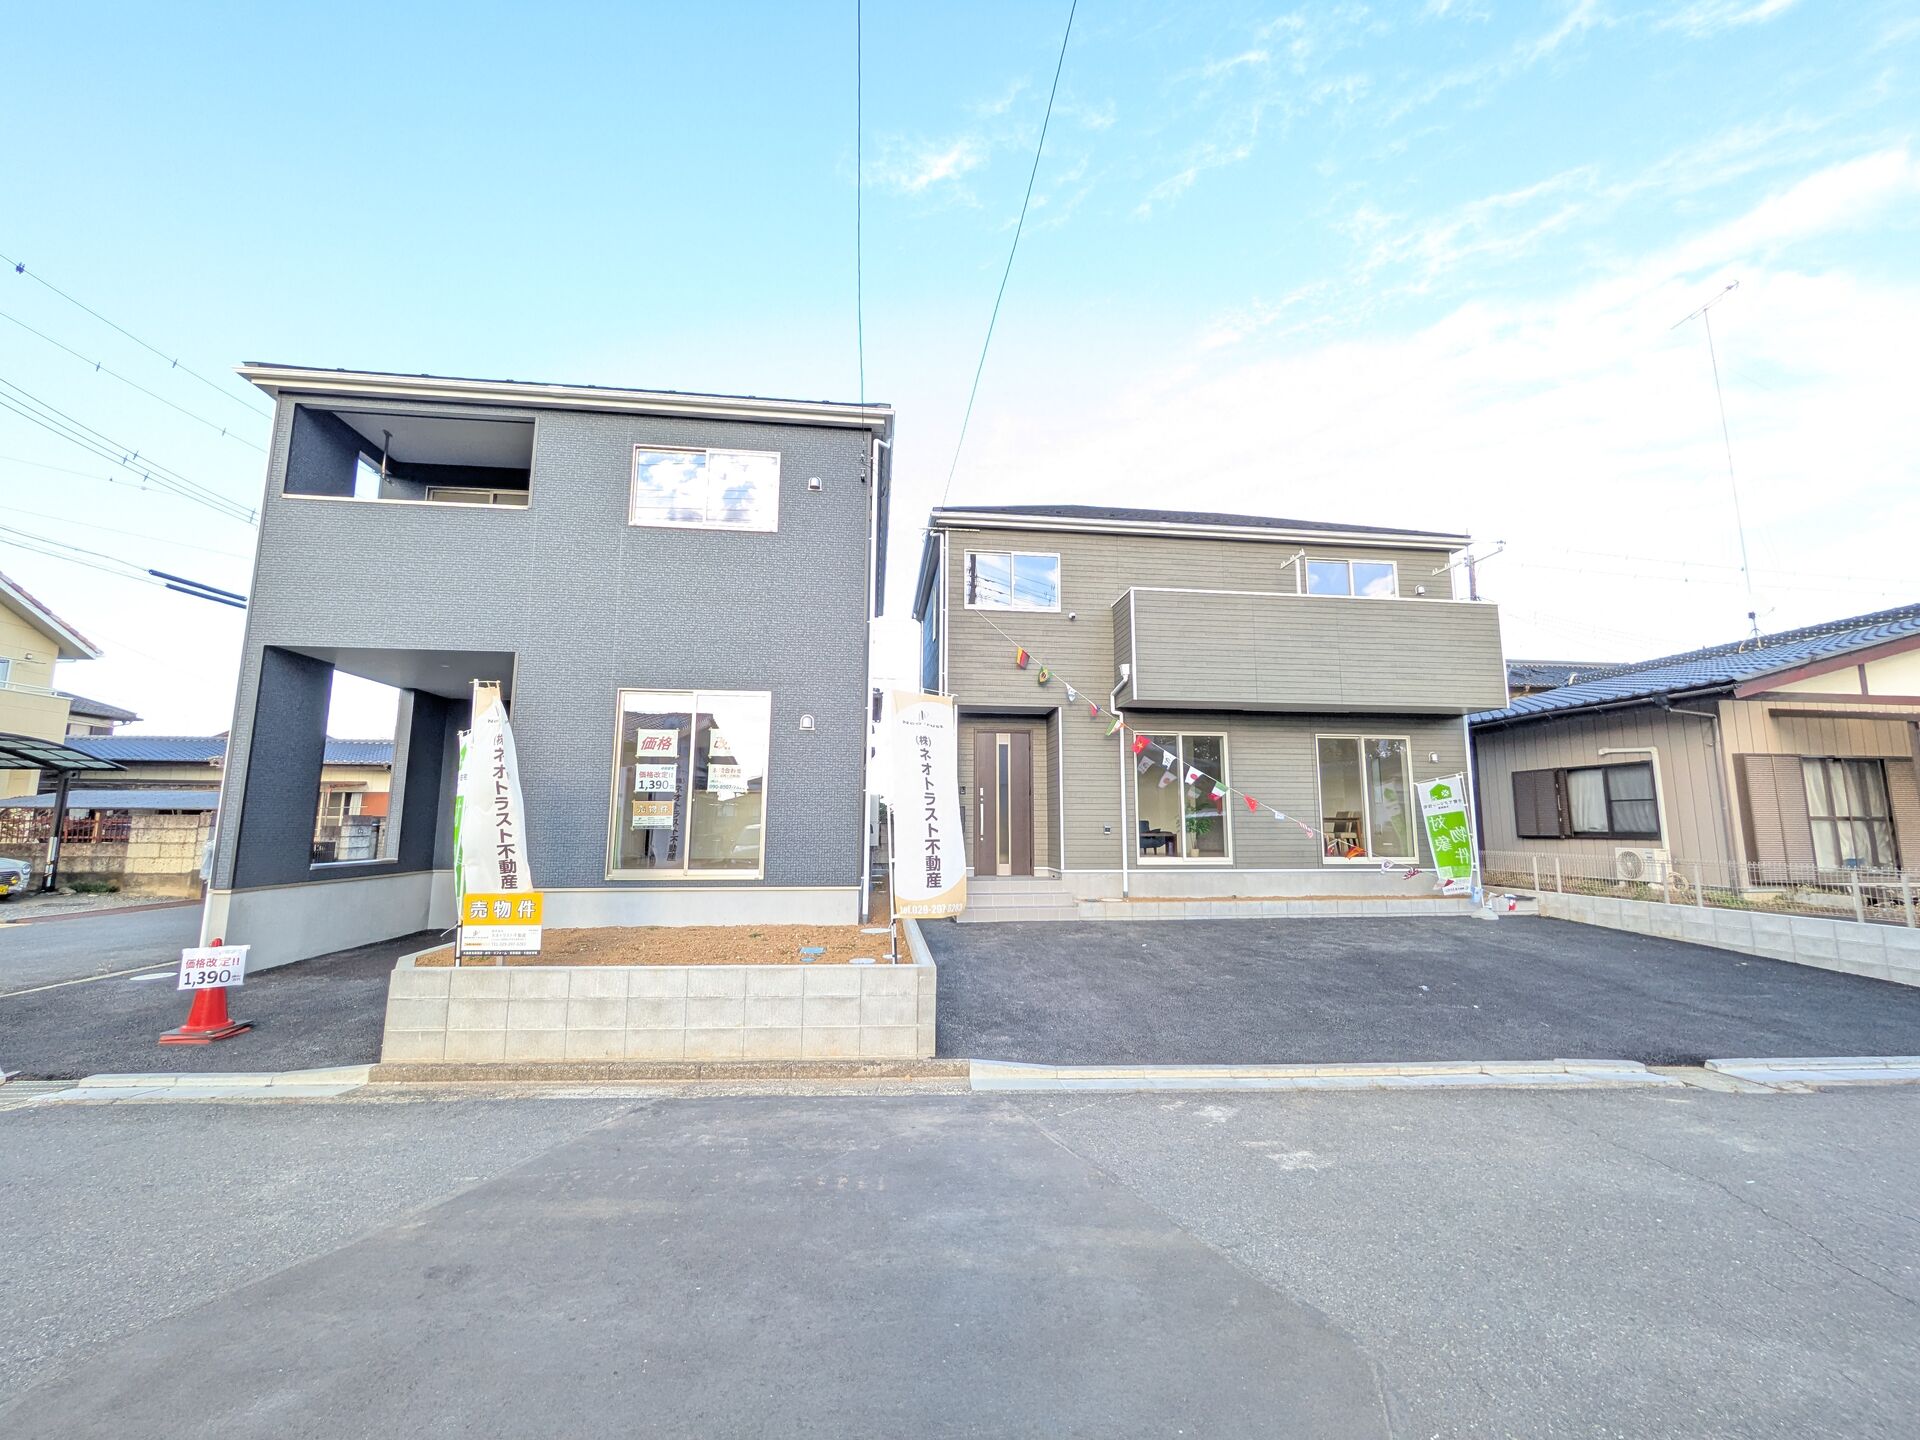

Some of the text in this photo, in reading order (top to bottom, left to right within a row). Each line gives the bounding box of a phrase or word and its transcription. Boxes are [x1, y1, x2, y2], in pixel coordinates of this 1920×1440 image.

[641, 736, 672, 750] 価格
[638, 780, 669, 791] 1,390
[493, 734, 518, 890] (株ネオトラスト不動産
[915, 735, 942, 889] (株)ネオトラスト不動産
[470, 900, 536, 918] 売物件
[185, 957, 240, 969] 価格改定!!
[184, 969, 231, 987] 1,390
